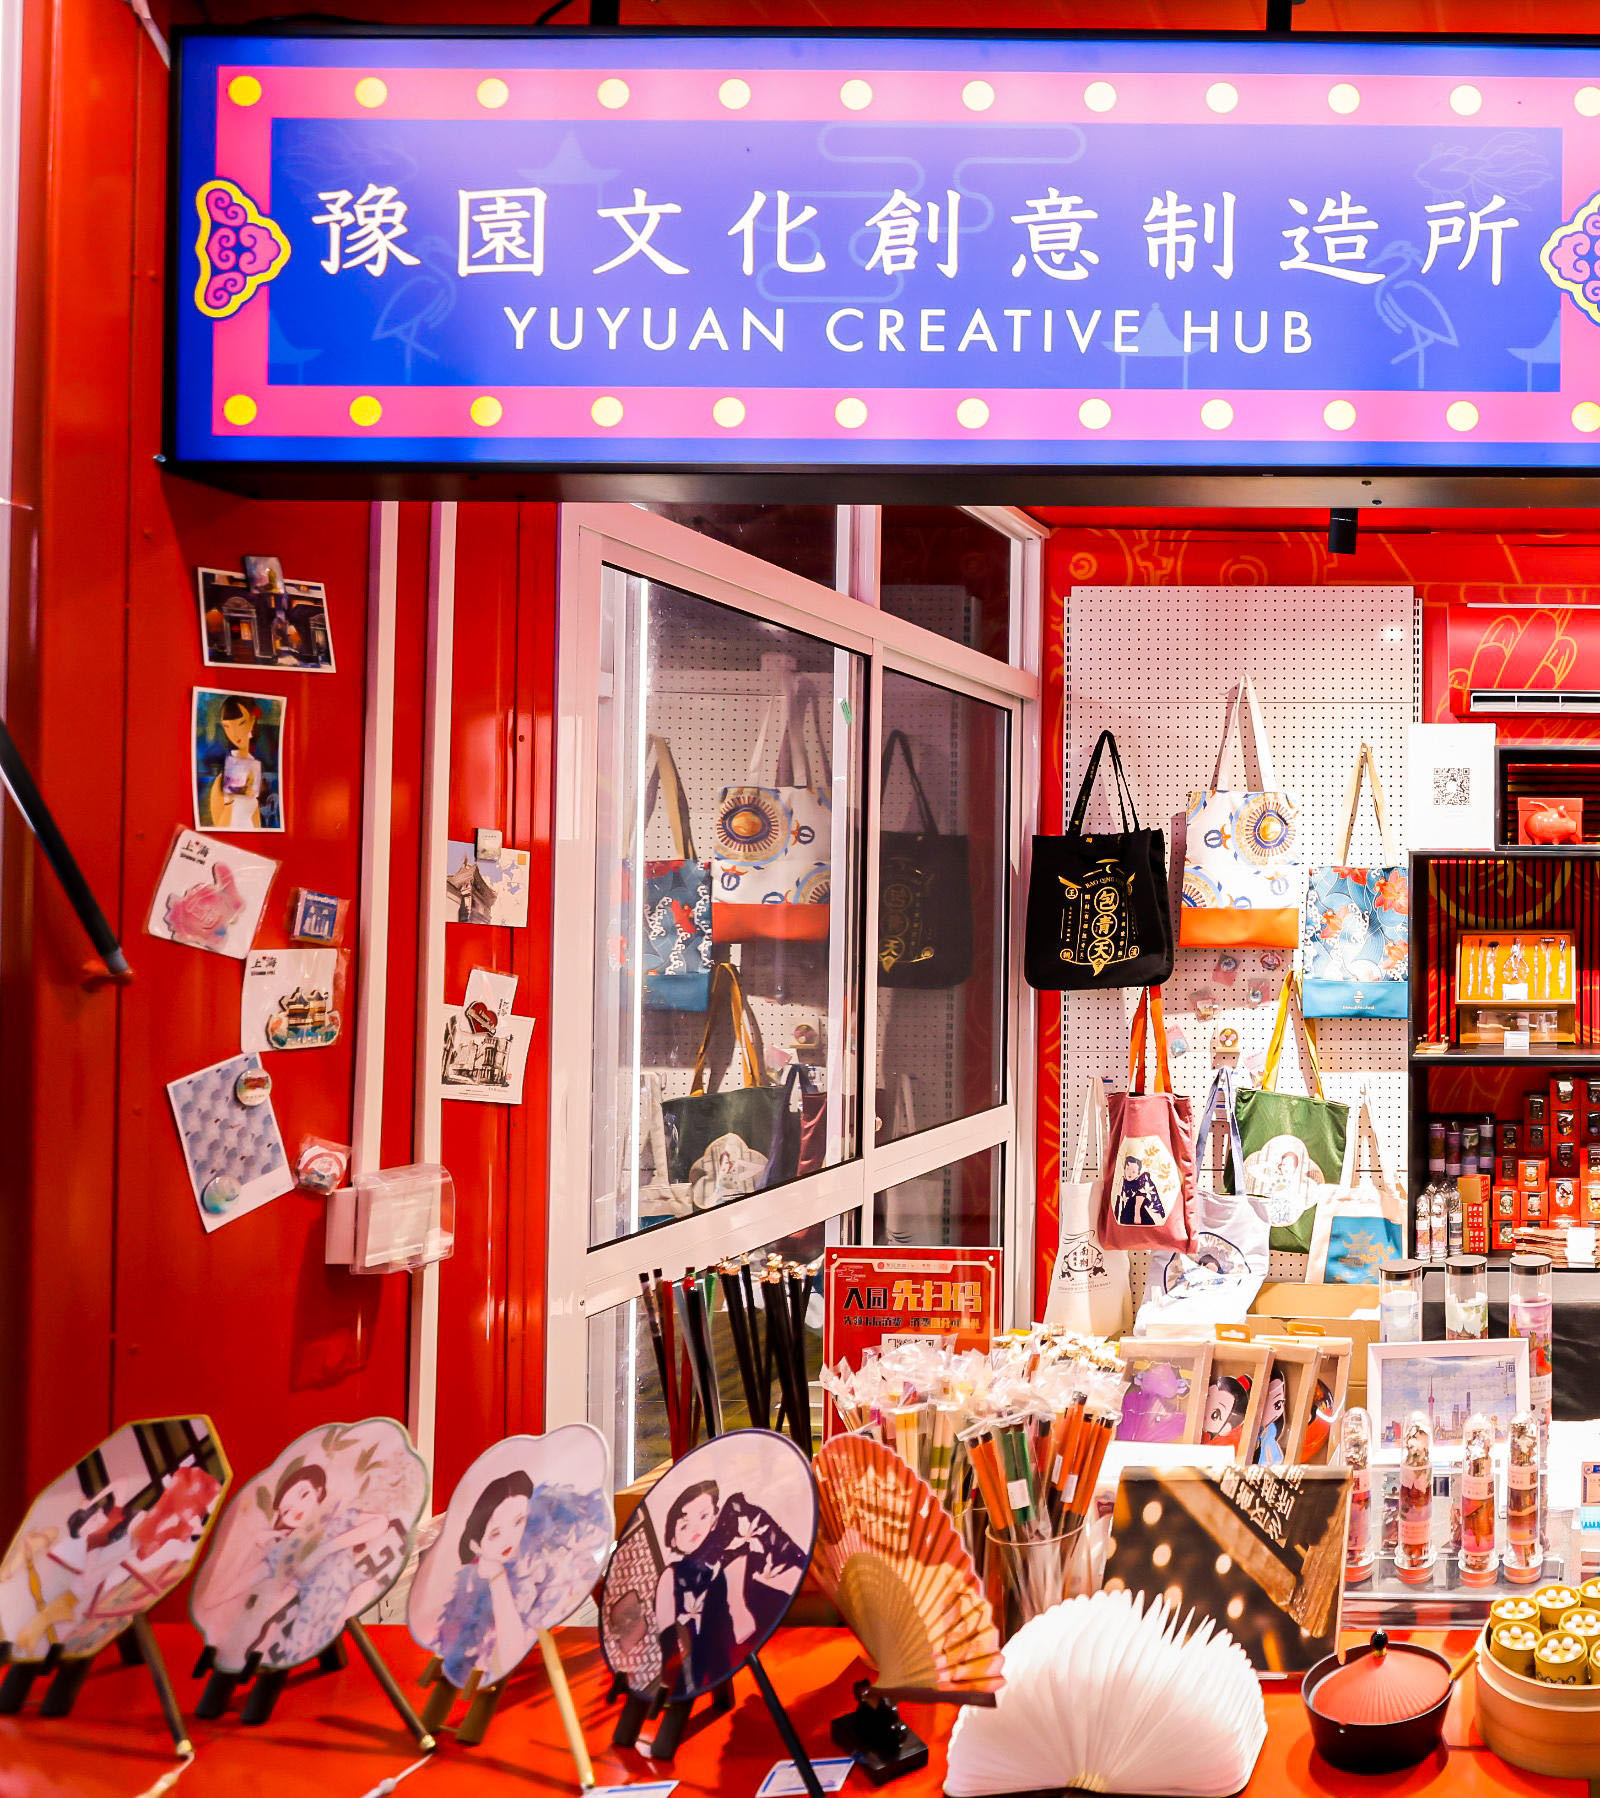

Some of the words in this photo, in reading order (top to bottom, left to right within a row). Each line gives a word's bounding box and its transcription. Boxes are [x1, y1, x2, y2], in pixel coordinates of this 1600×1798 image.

[312, 183, 1520, 286] 豫園文化創意制造所
[504, 306, 786, 352] YUYUAN
[825, 307, 1142, 354] CREATIVE
[1184, 310, 1314, 354] HUB
[1091, 890, 1116, 959] 包青天
